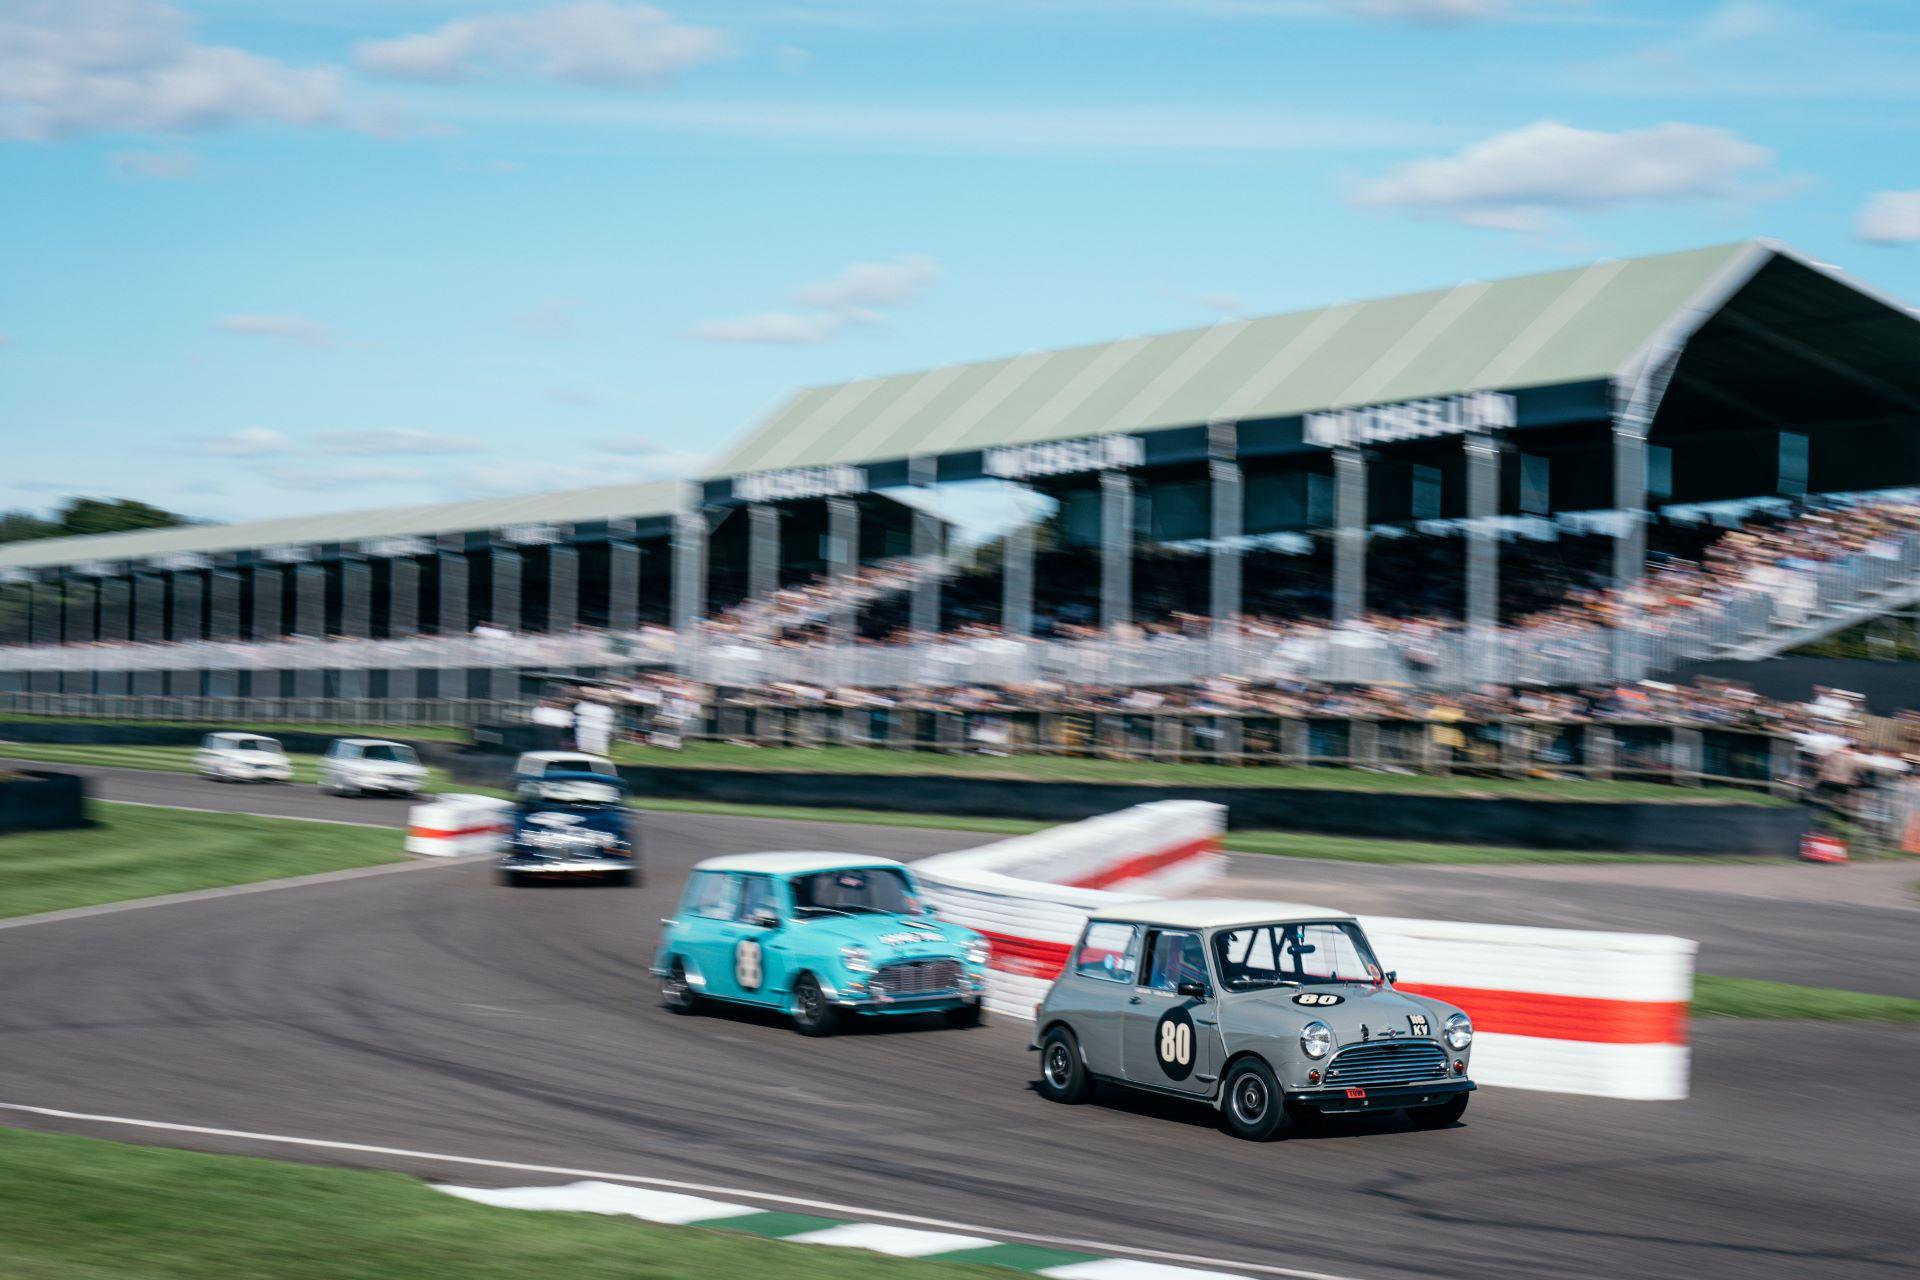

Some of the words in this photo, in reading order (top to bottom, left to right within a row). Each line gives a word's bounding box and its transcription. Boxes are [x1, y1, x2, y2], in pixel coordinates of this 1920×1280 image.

[1299, 994, 1338, 1005] 80
[1412, 1024, 1428, 1036] KV
[1161, 1020, 1190, 1065] 80
